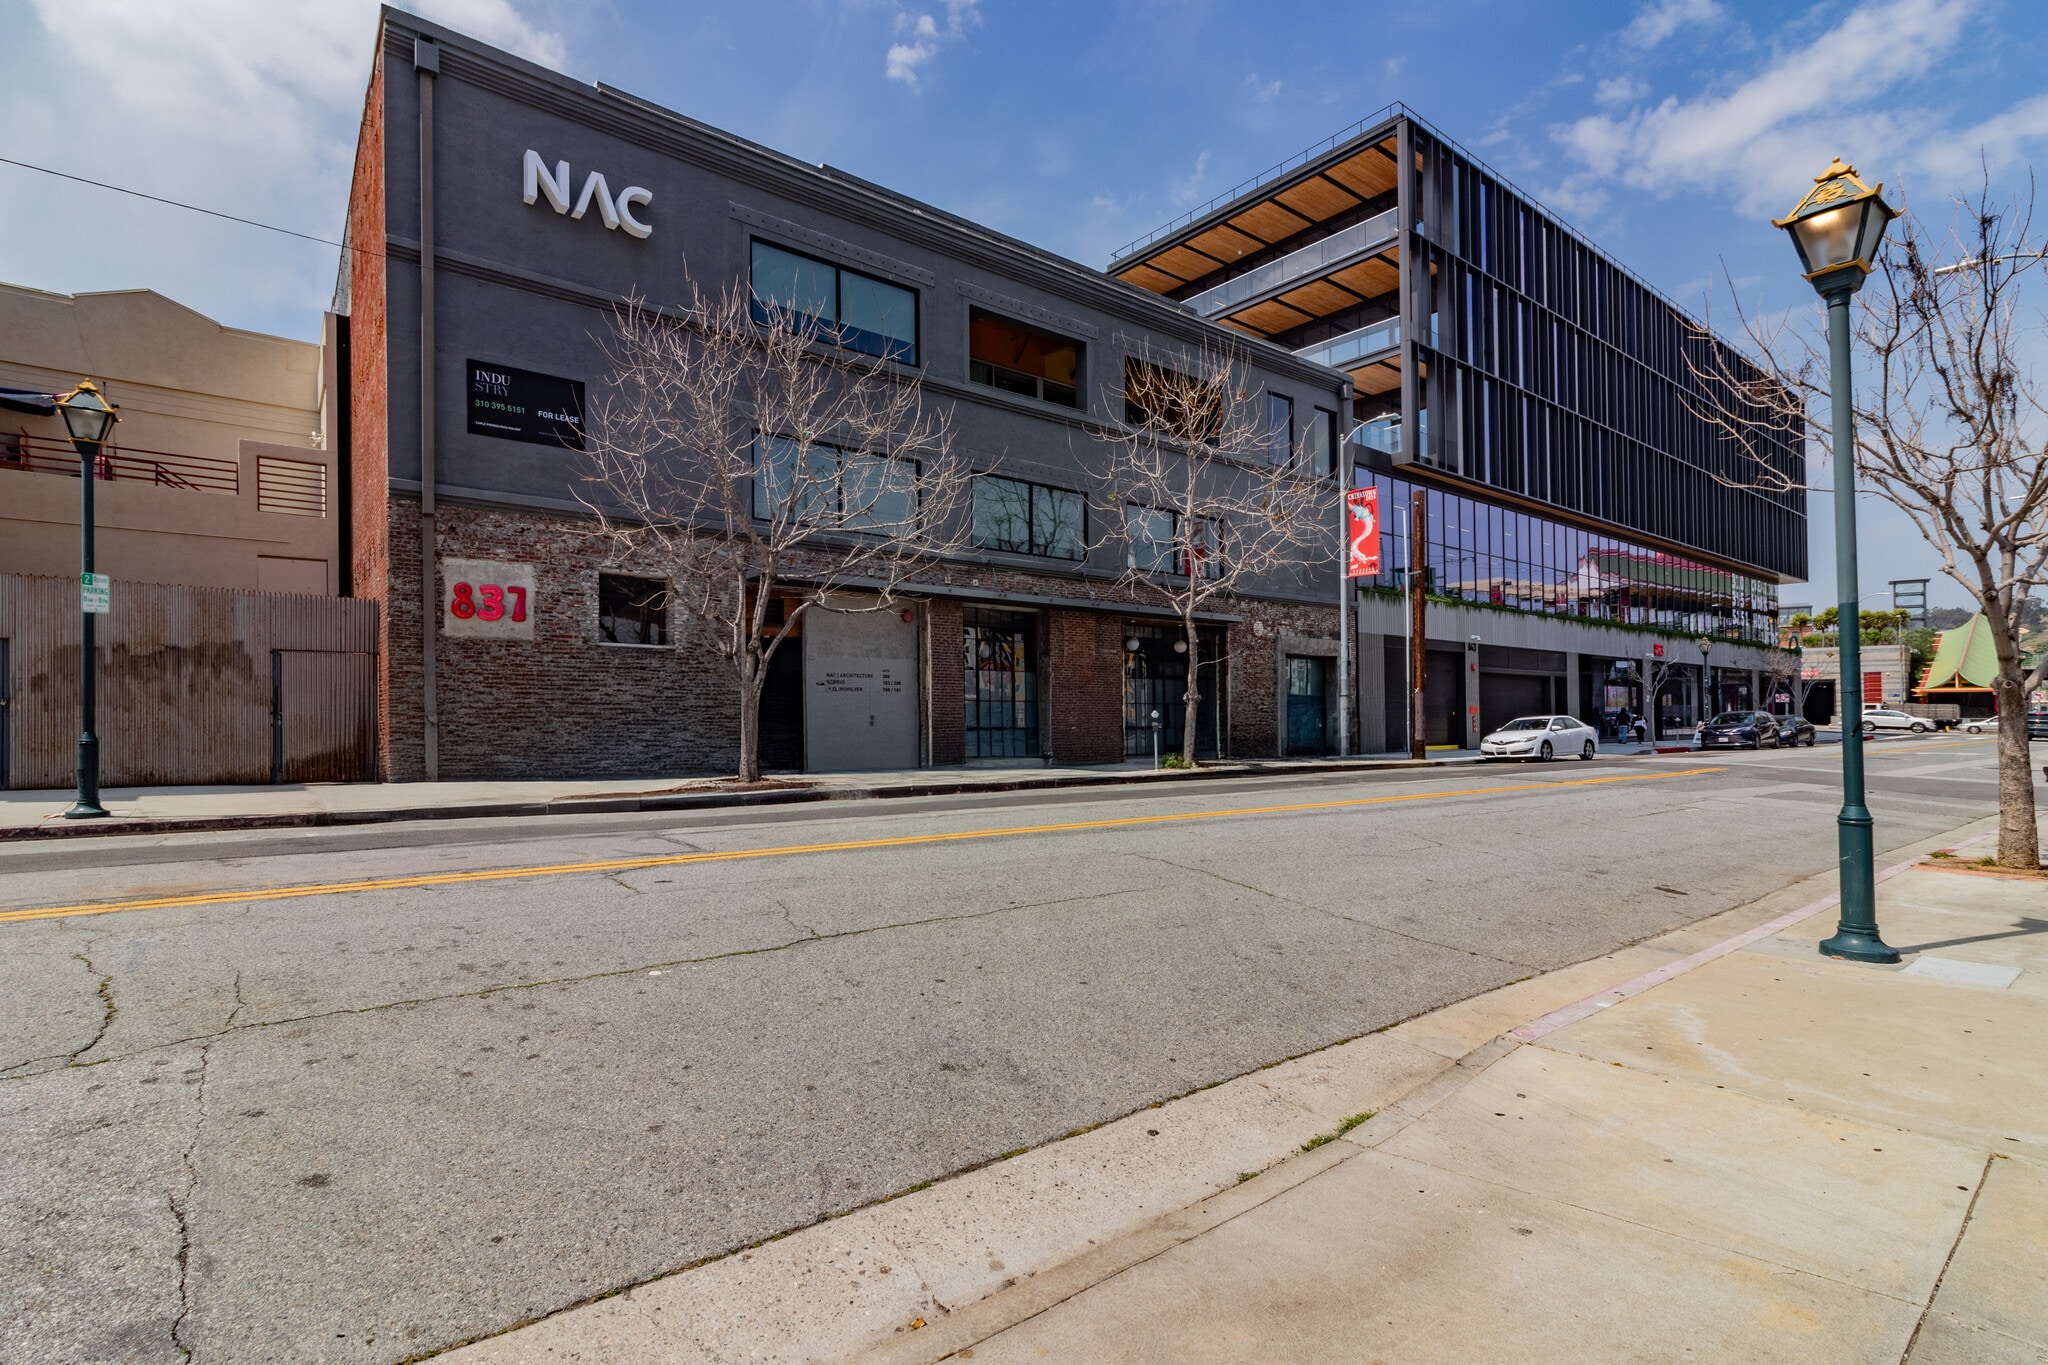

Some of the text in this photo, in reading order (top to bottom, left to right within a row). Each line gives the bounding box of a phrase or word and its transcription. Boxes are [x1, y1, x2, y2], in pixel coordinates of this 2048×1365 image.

[523, 149, 653, 240] NAC
[475, 370, 511, 386] INDU
[475, 382, 511, 397] STRY
[475, 400, 525, 415] 310 395 5151
[537, 410, 580, 425] FOR LEASE
[84, 574, 90, 584] 2
[83, 586, 108, 596] PARKING
[451, 581, 527, 623] 837
